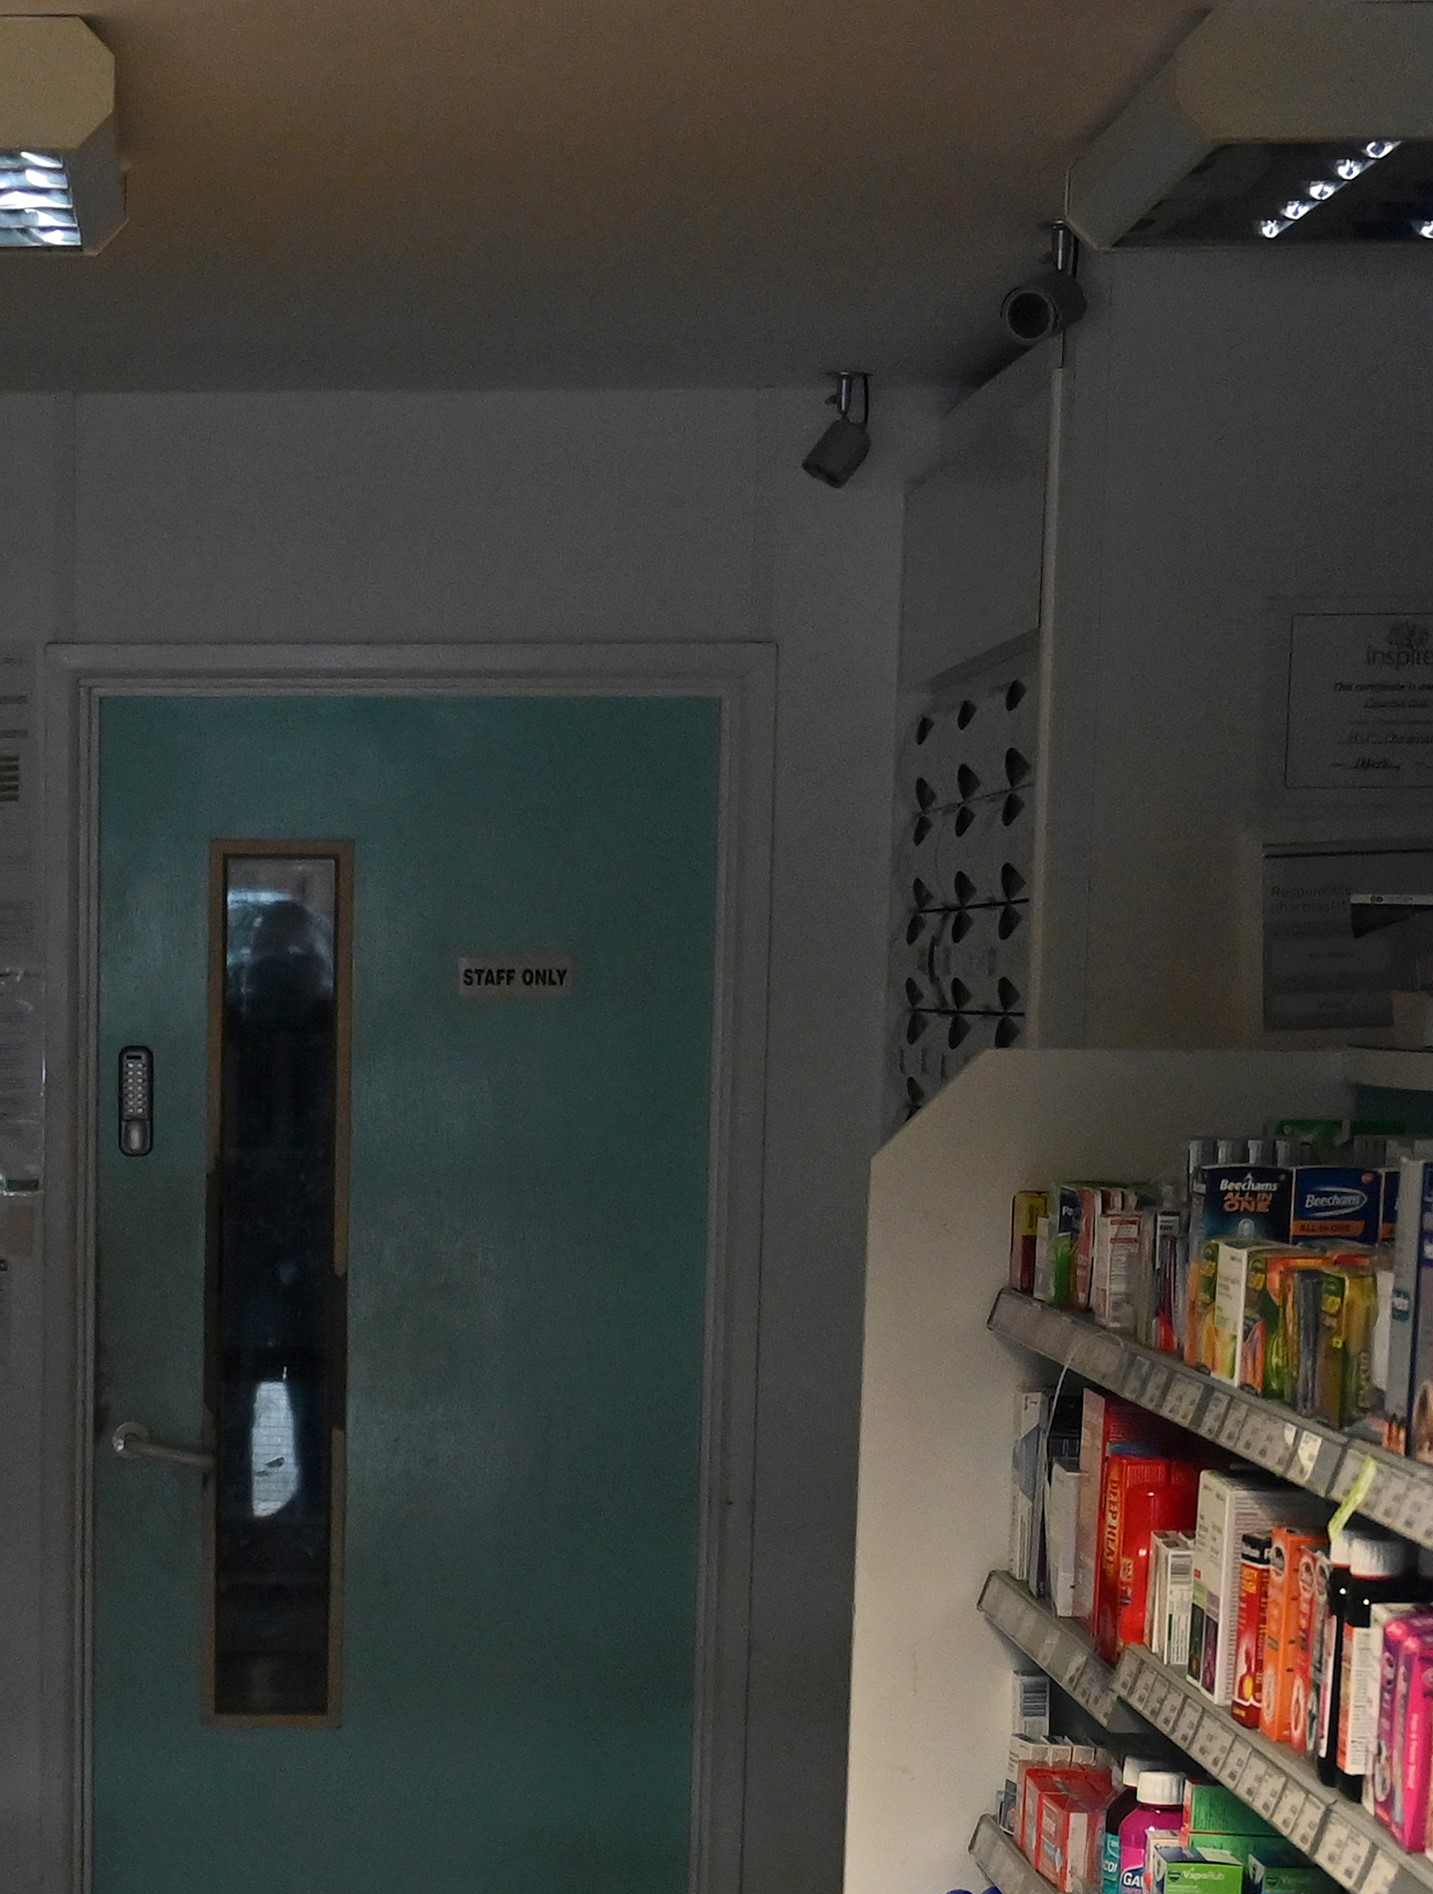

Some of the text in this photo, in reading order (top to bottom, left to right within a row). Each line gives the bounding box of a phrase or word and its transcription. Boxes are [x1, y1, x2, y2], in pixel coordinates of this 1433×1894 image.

[463, 968, 567, 986] STAFF ONLY
[1220, 1178, 1280, 1192] Beechams
[1223, 1200, 1271, 1213] ONE
